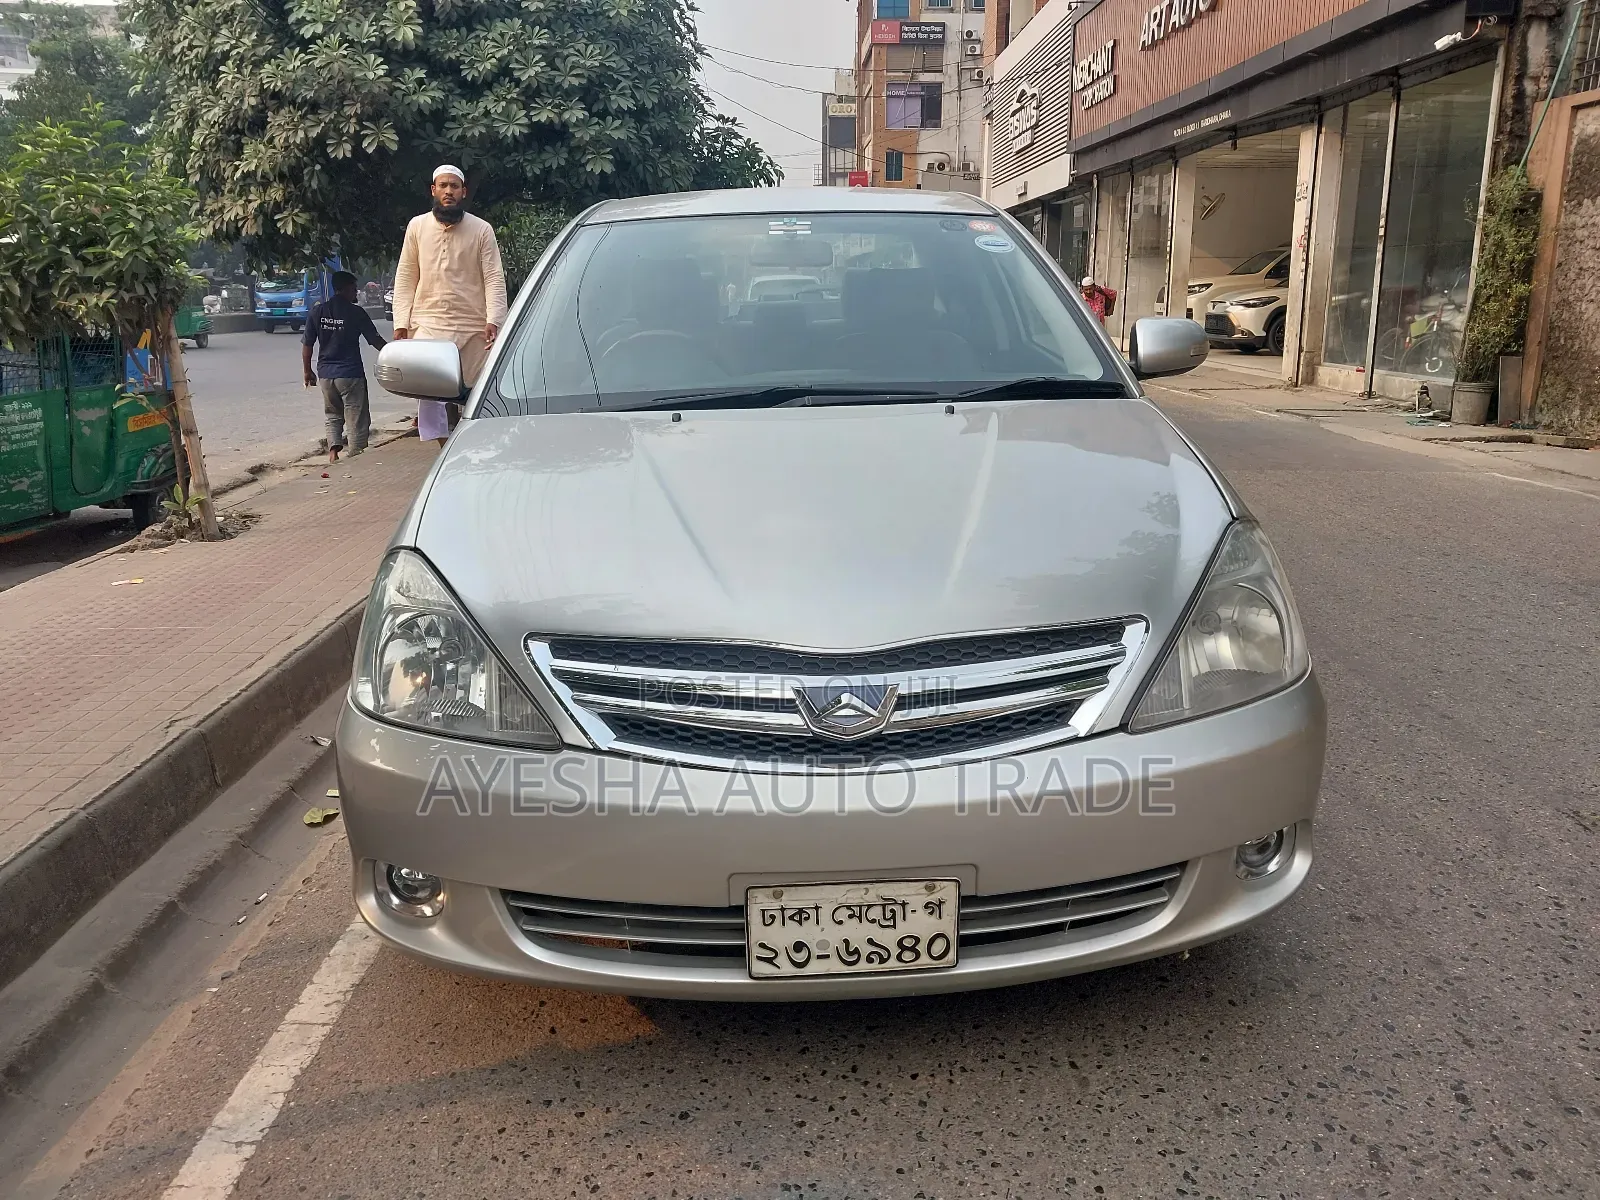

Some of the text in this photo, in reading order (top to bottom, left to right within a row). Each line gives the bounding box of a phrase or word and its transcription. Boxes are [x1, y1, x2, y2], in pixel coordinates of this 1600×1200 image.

[1139, 0, 1212, 51] ART AU
[1072, 39, 1114, 92] MERCHANT
[760, 902, 823, 927] ঢাকা
[755, 932, 950, 970] ২৩-৬৯৪০
